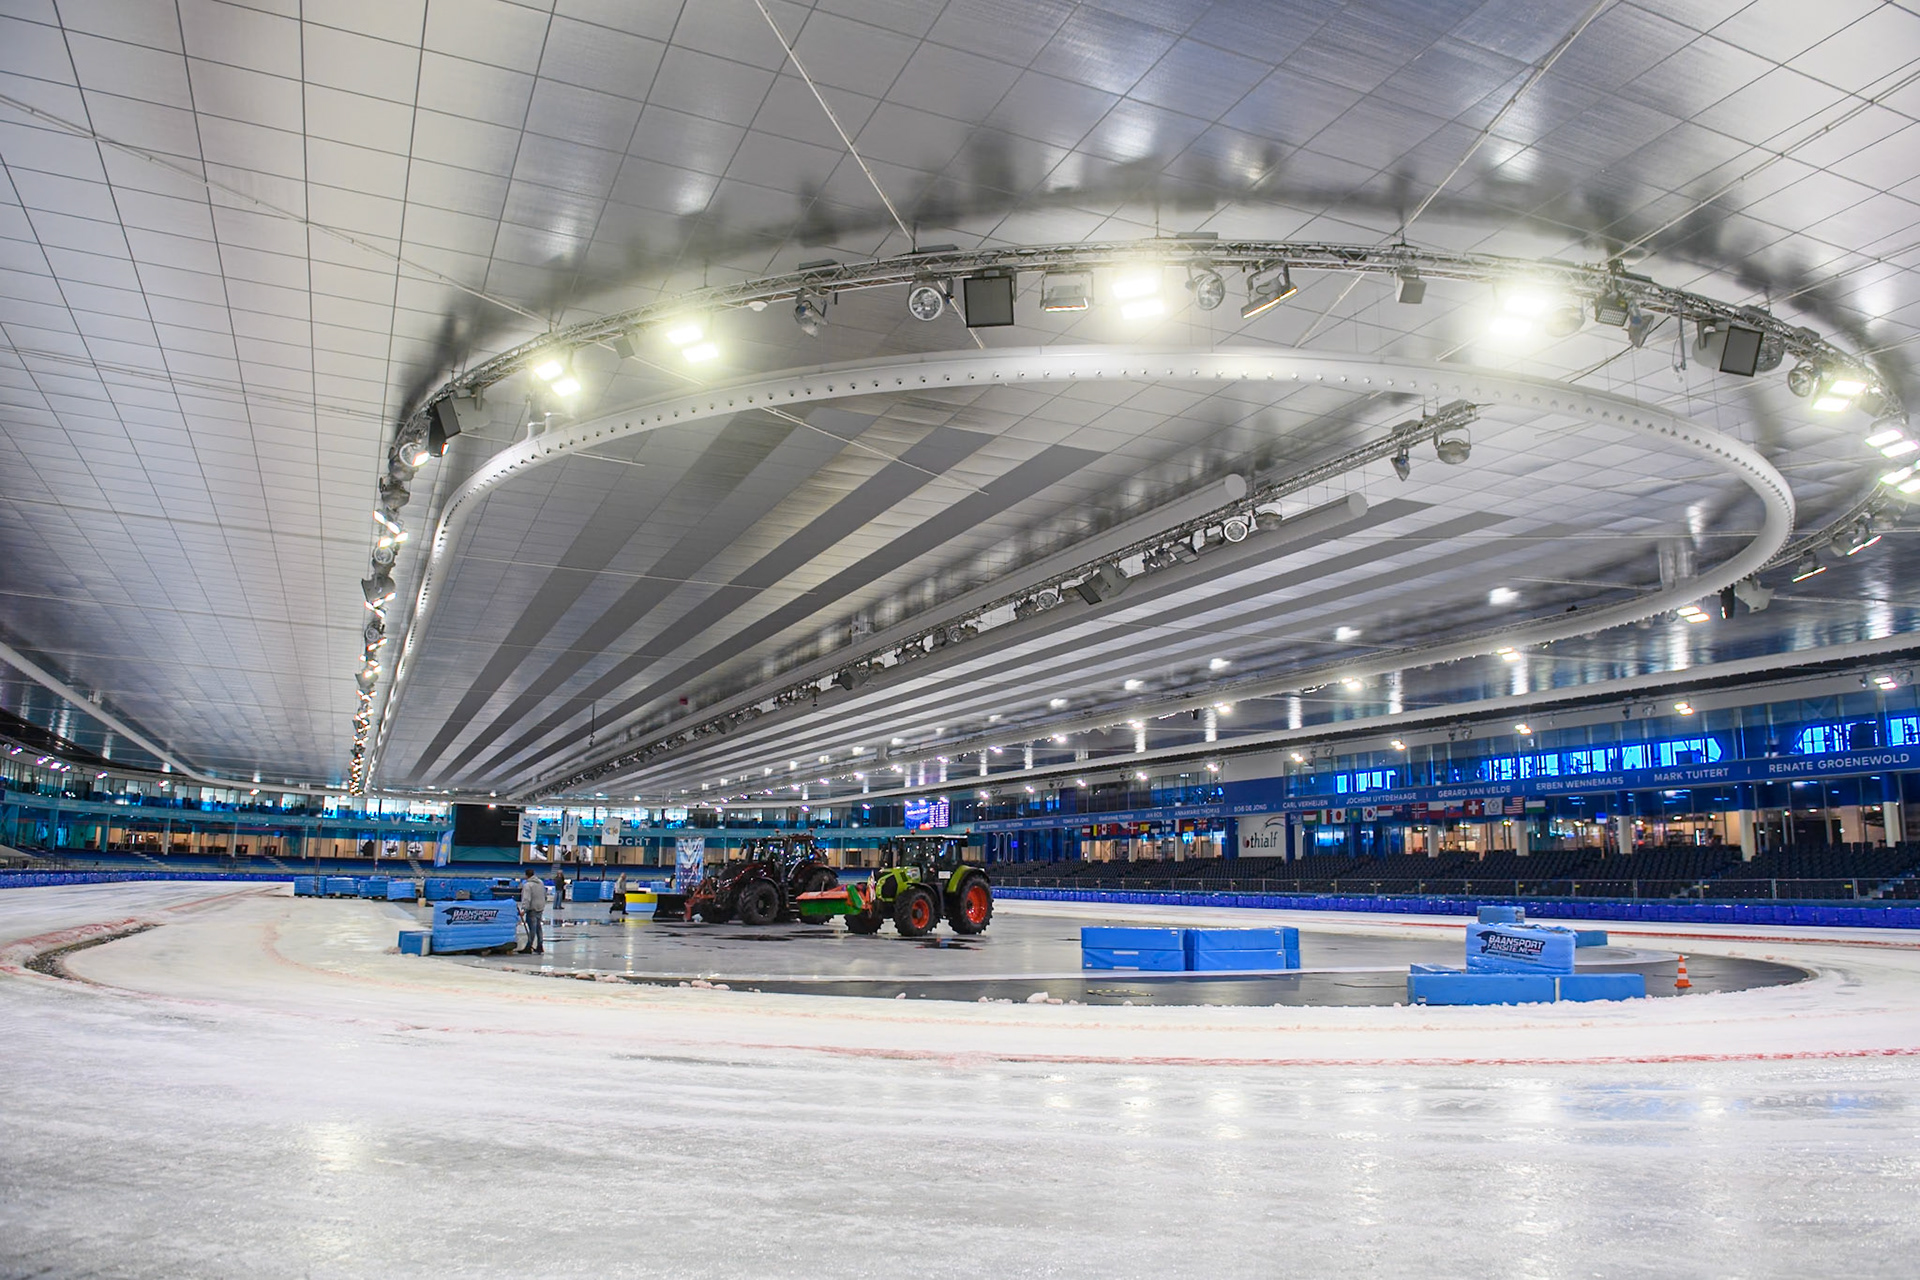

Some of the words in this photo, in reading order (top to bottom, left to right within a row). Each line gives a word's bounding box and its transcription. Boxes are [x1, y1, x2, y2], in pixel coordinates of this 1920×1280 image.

[1769, 761, 1813, 773] RENATE
[1818, 753, 1910, 769] GROENEWOLD
[1654, 772, 1683, 782] MARK
[1686, 768, 1729, 780] TUITERT
[1536, 781, 1563, 791] ERBEN
[1565, 776, 1624, 789] WENNEMARS
[1346, 796, 1372, 805] JOCHEM
[1373, 792, 1417, 802] UYTDEHAAGE
[1438, 789, 1467, 798] GERARD
[1468, 787, 1485, 796] VAN
[1486, 785, 1511, 794] VELDE
[1250, 831, 1278, 848] thialf
[1489, 935, 1544, 949] BAANSPORT
